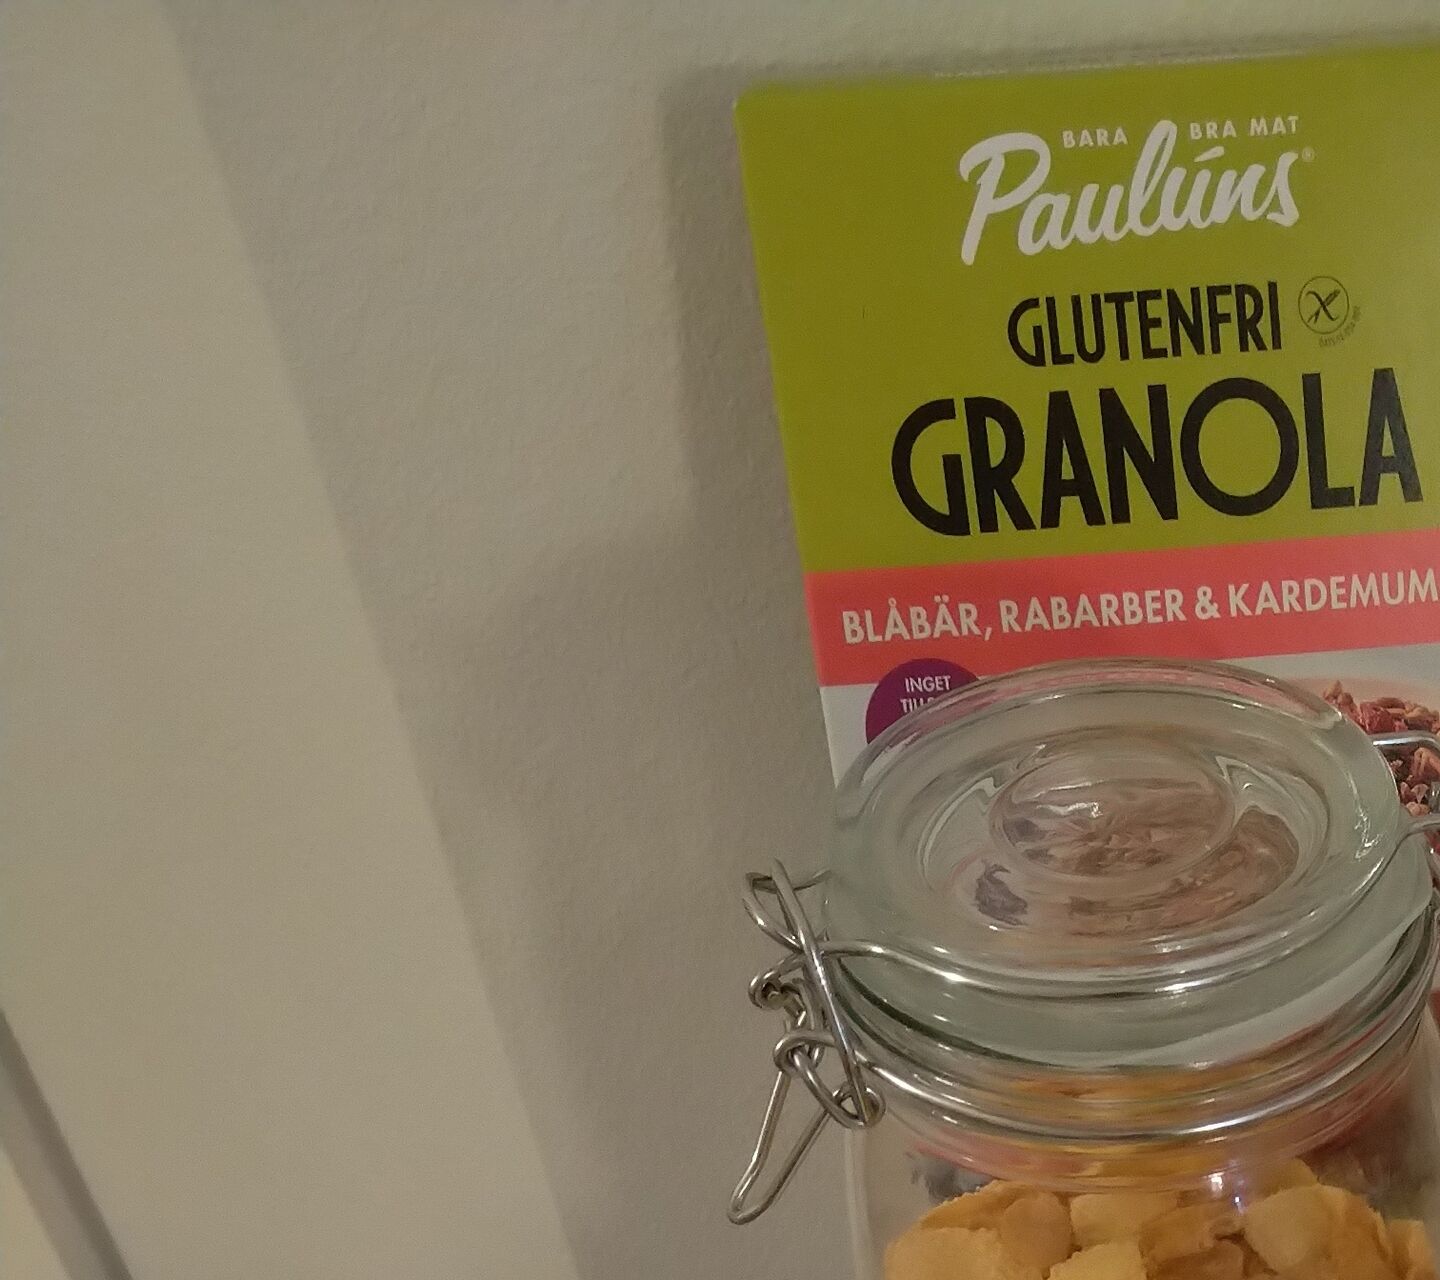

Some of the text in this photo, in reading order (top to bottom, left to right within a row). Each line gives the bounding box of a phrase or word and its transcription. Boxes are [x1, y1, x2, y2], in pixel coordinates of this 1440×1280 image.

[1063, 115, 1299, 148] BARA BRA MAT
[958, 119, 1300, 266] Paulúns
[1007, 281, 1282, 367] GLUTENFRI
[891, 367, 1424, 537] GRANOLA
[842, 596, 992, 645] BLÅBÄR,
[1000, 587, 1183, 635] RABARBER
[1195, 586, 1219, 619] &
[904, 675, 951, 693] INGET
